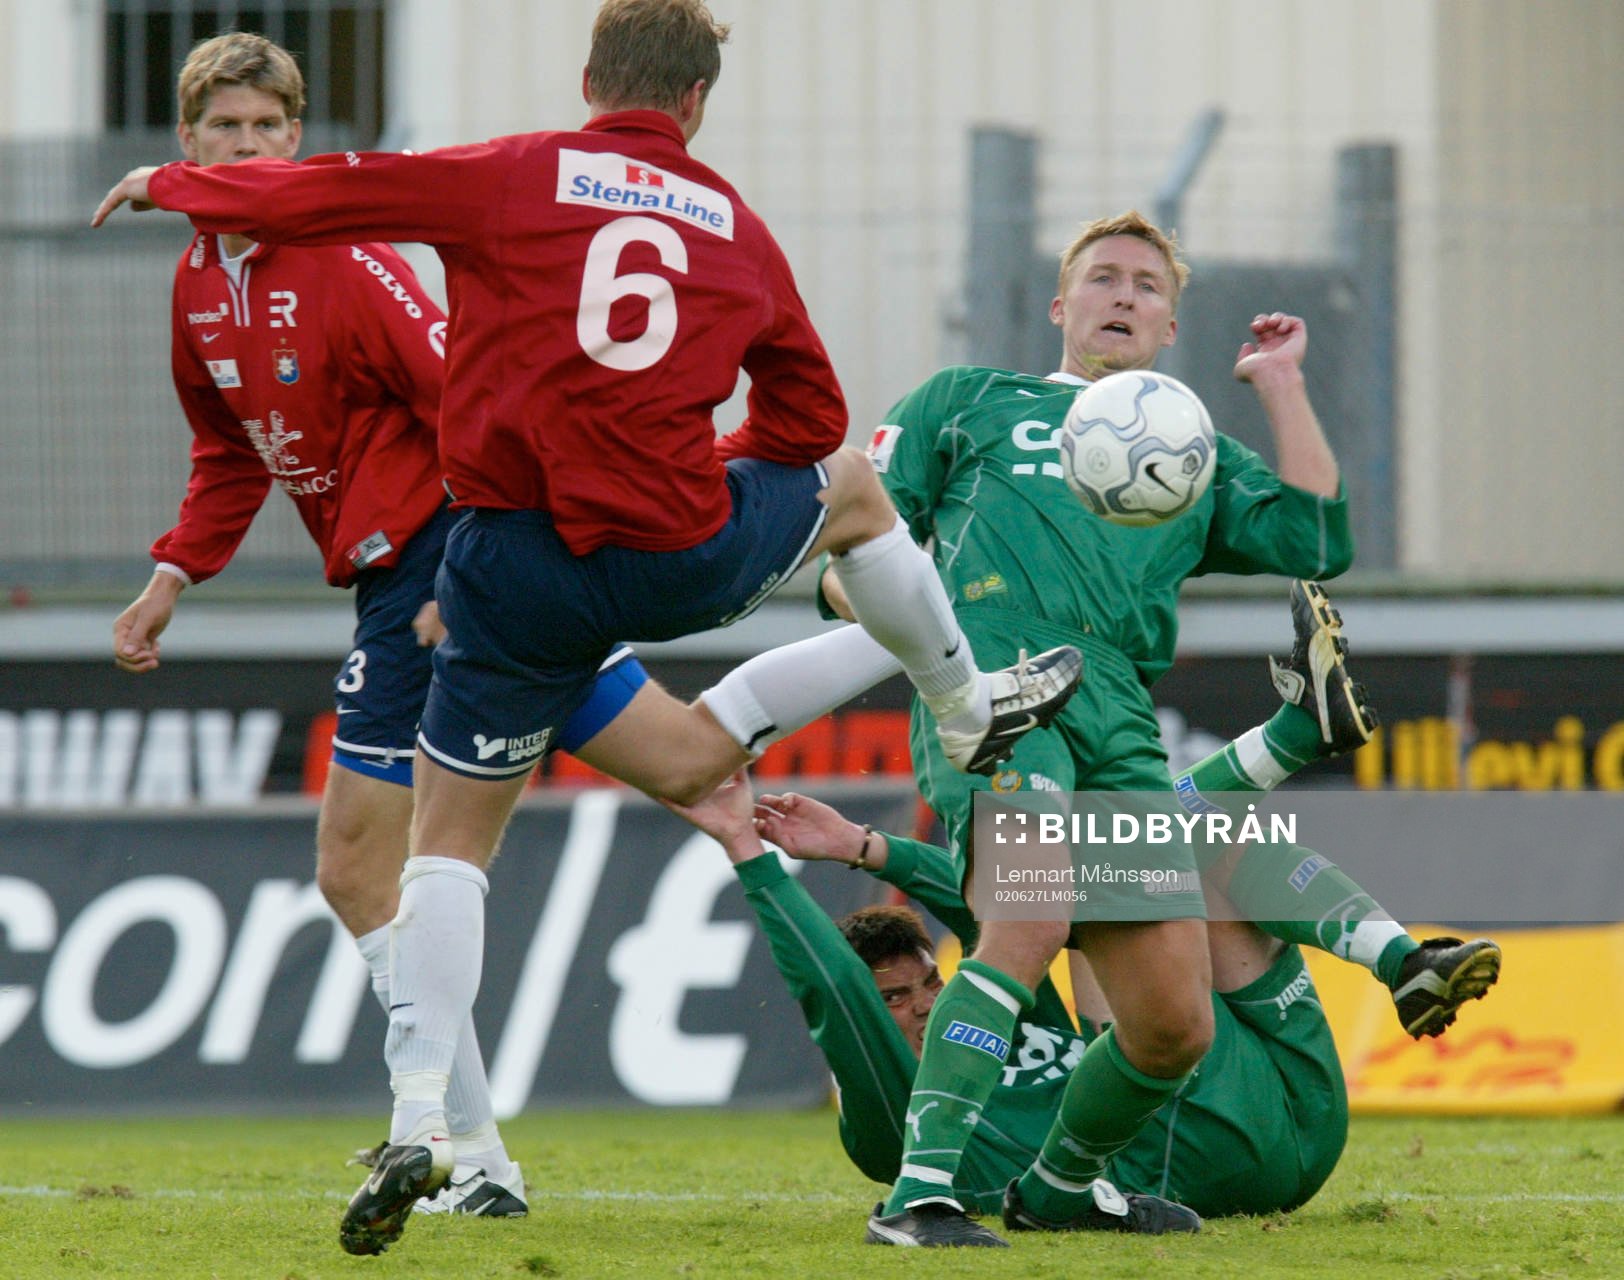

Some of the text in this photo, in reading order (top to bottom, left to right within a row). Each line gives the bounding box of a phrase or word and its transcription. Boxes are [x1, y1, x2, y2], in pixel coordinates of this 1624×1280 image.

[350, 245, 423, 319] VOLVO
[576, 215, 689, 372] 6
[336, 649, 366, 694] 3
[507, 726, 550, 751] INTER
[507, 740, 548, 762] SPORT
[945, 1022, 1010, 1060] FIAT
